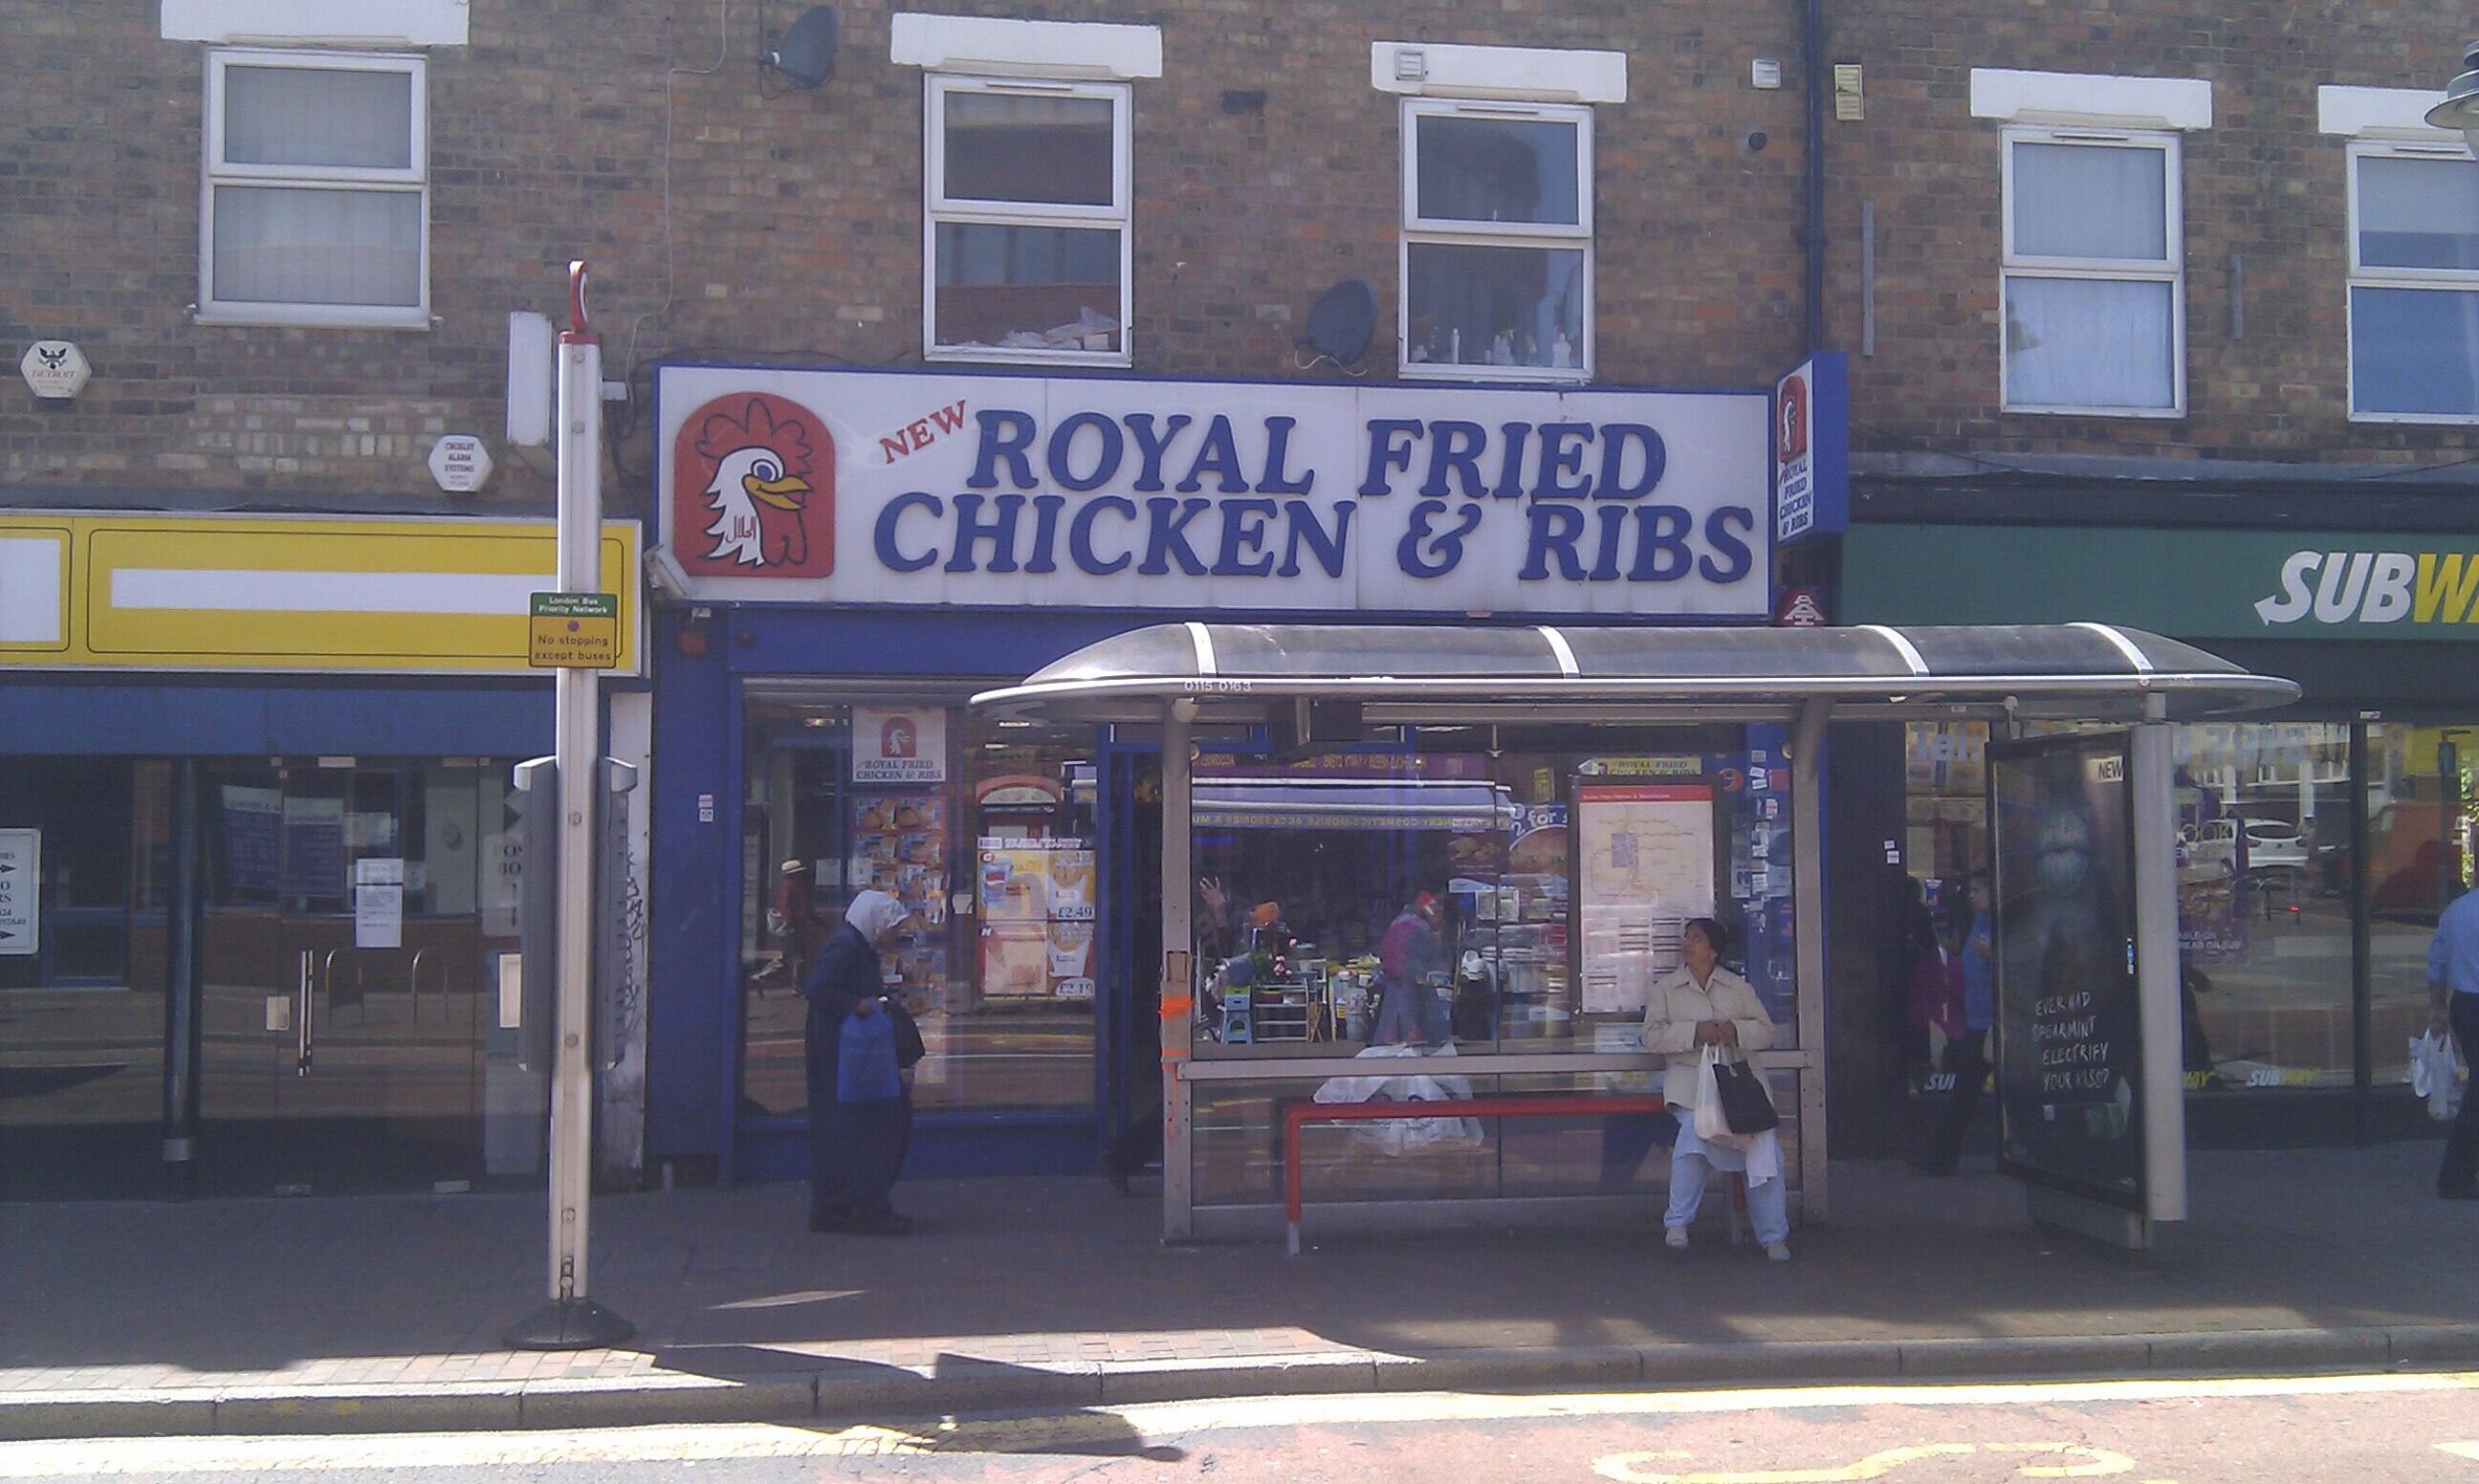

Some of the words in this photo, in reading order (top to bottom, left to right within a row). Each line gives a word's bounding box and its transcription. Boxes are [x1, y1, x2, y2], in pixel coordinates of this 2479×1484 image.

[879, 399, 968, 465] NEW
[966, 408, 1315, 495] ROYAL
[1358, 418, 1668, 502] FRIED
[444, 464, 474, 472] SYSTEMS
[1785, 459, 1807, 483] ROYAL
[1785, 477, 1807, 500] FRIED
[1780, 491, 1812, 520] CHICKEN
[874, 491, 1358, 578] CHICKEN
[1395, 499, 1483, 578] &
[1518, 504, 1755, 583] RIBS
[538, 604, 569, 614] Priority
[549, 597, 579, 605] London
[537, 635, 554, 644] No
[559, 636, 608, 647] stopping
[535, 651, 573, 662] except
[578, 652, 611, 661] buses
[1218, 682, 1251, 692] 0163
[865, 760, 897, 769] ROYAL
[902, 760, 933, 769] FRIED
[2098, 761, 2122, 780] NEW
[856, 770, 902, 779] CHICKEN
[918, 770, 942, 779] RIBS
[1527, 810, 1557, 828] for
[1058, 906, 1092, 918] £2.49
[1060, 982, 1093, 993] £2.19
[2035, 996, 2066, 1015] EVER
[2068, 991, 2091, 1010] HAD
[2031, 1015, 2096, 1042] SPEARMINT
[2042, 1041, 2109, 1065] ELECTRIFY
[2043, 1071, 2072, 1094] YOUR
